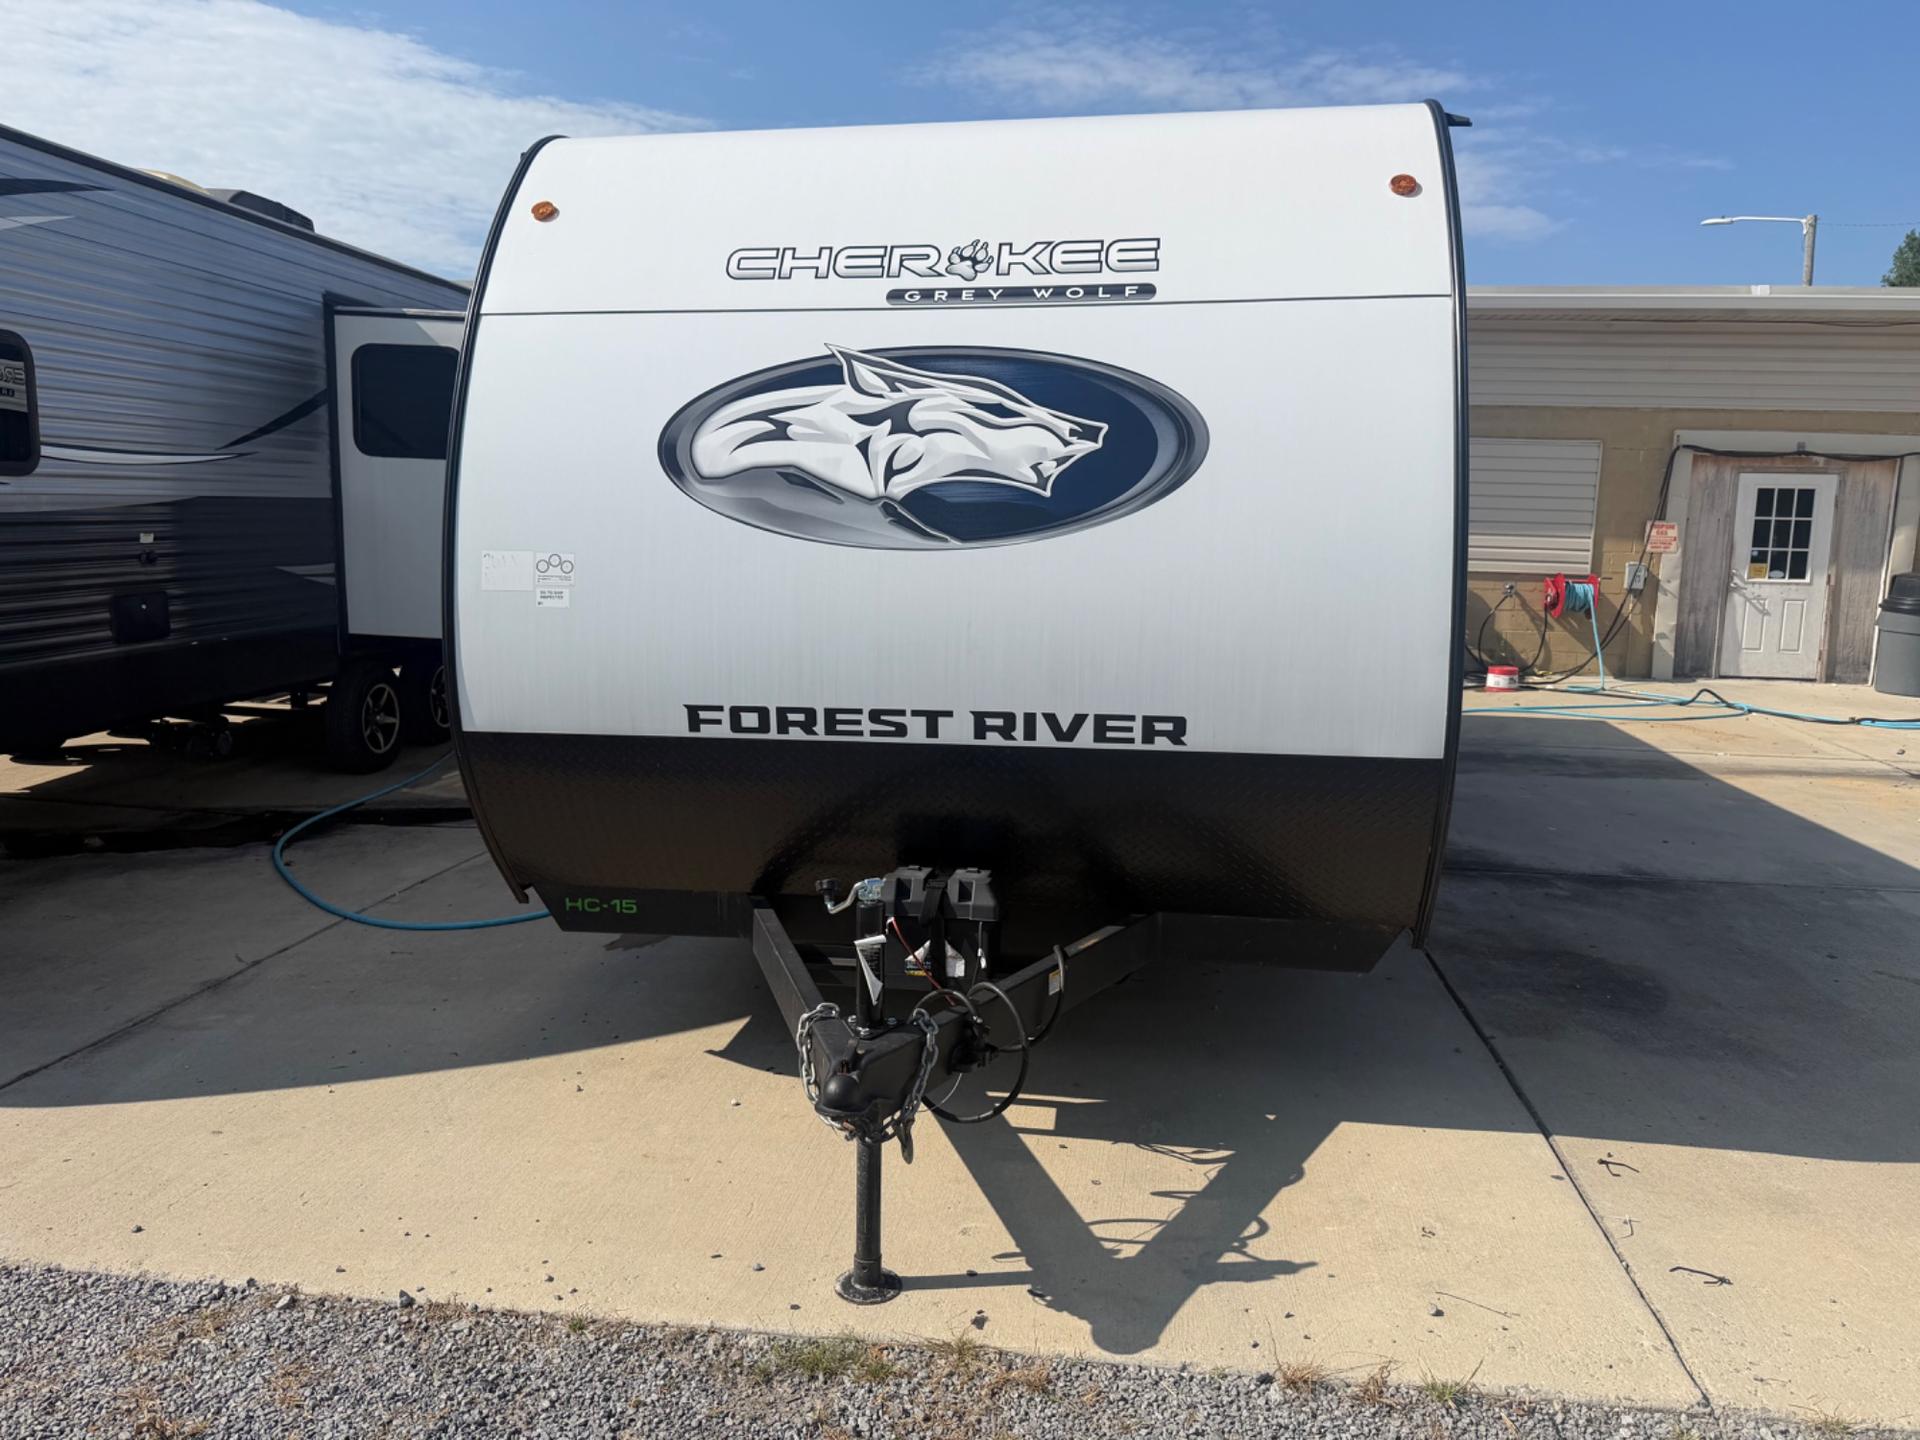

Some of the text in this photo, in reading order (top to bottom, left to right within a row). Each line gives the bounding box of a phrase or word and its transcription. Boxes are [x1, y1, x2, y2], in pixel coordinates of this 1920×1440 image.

[904, 286, 1139, 301] GREY WOLF
[682, 704, 1188, 746] FOREST RIVER
[565, 897, 637, 913] HC-15
